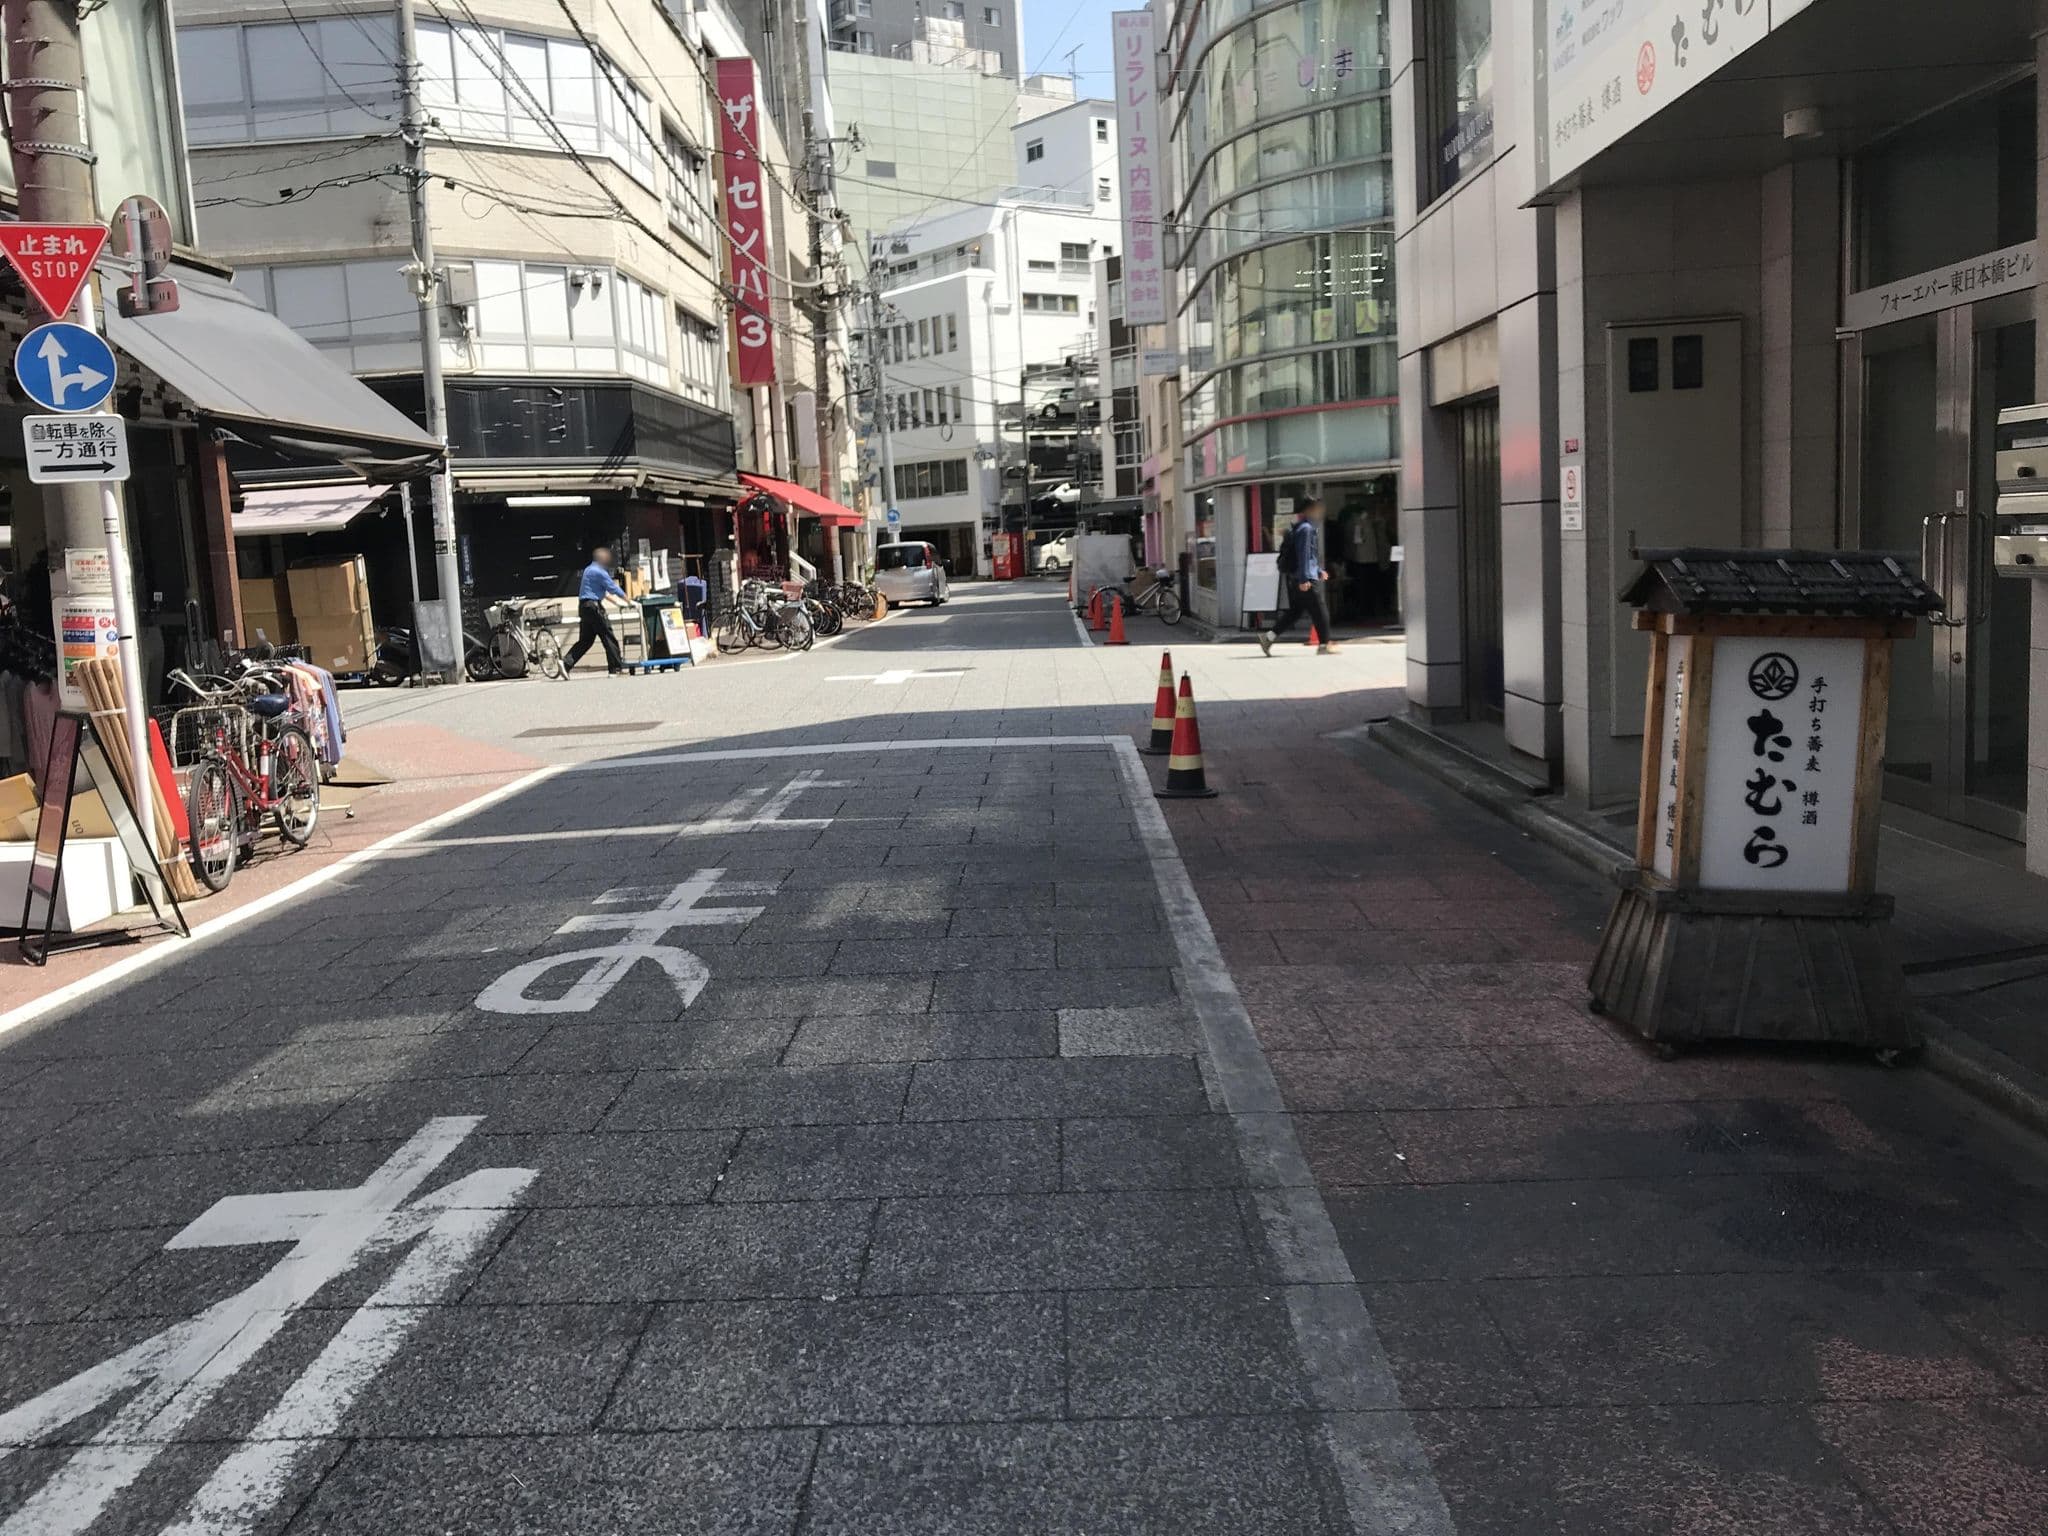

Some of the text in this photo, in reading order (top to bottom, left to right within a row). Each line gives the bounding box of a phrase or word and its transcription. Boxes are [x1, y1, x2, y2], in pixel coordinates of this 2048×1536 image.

[1126, 35, 1149, 158] リラレーヌ
[17, 232, 88, 256] 止まれ
[31, 260, 79, 278] STOP
[1880, 252, 2034, 315] フォーエバー東日本橋ビル
[31, 422, 117, 440] 自転車を除く
[33, 440, 118, 459] 一方通行
[1802, 676, 1828, 826] 手打ち蕎麦 樽酒
[1744, 708, 1797, 869] たむら
